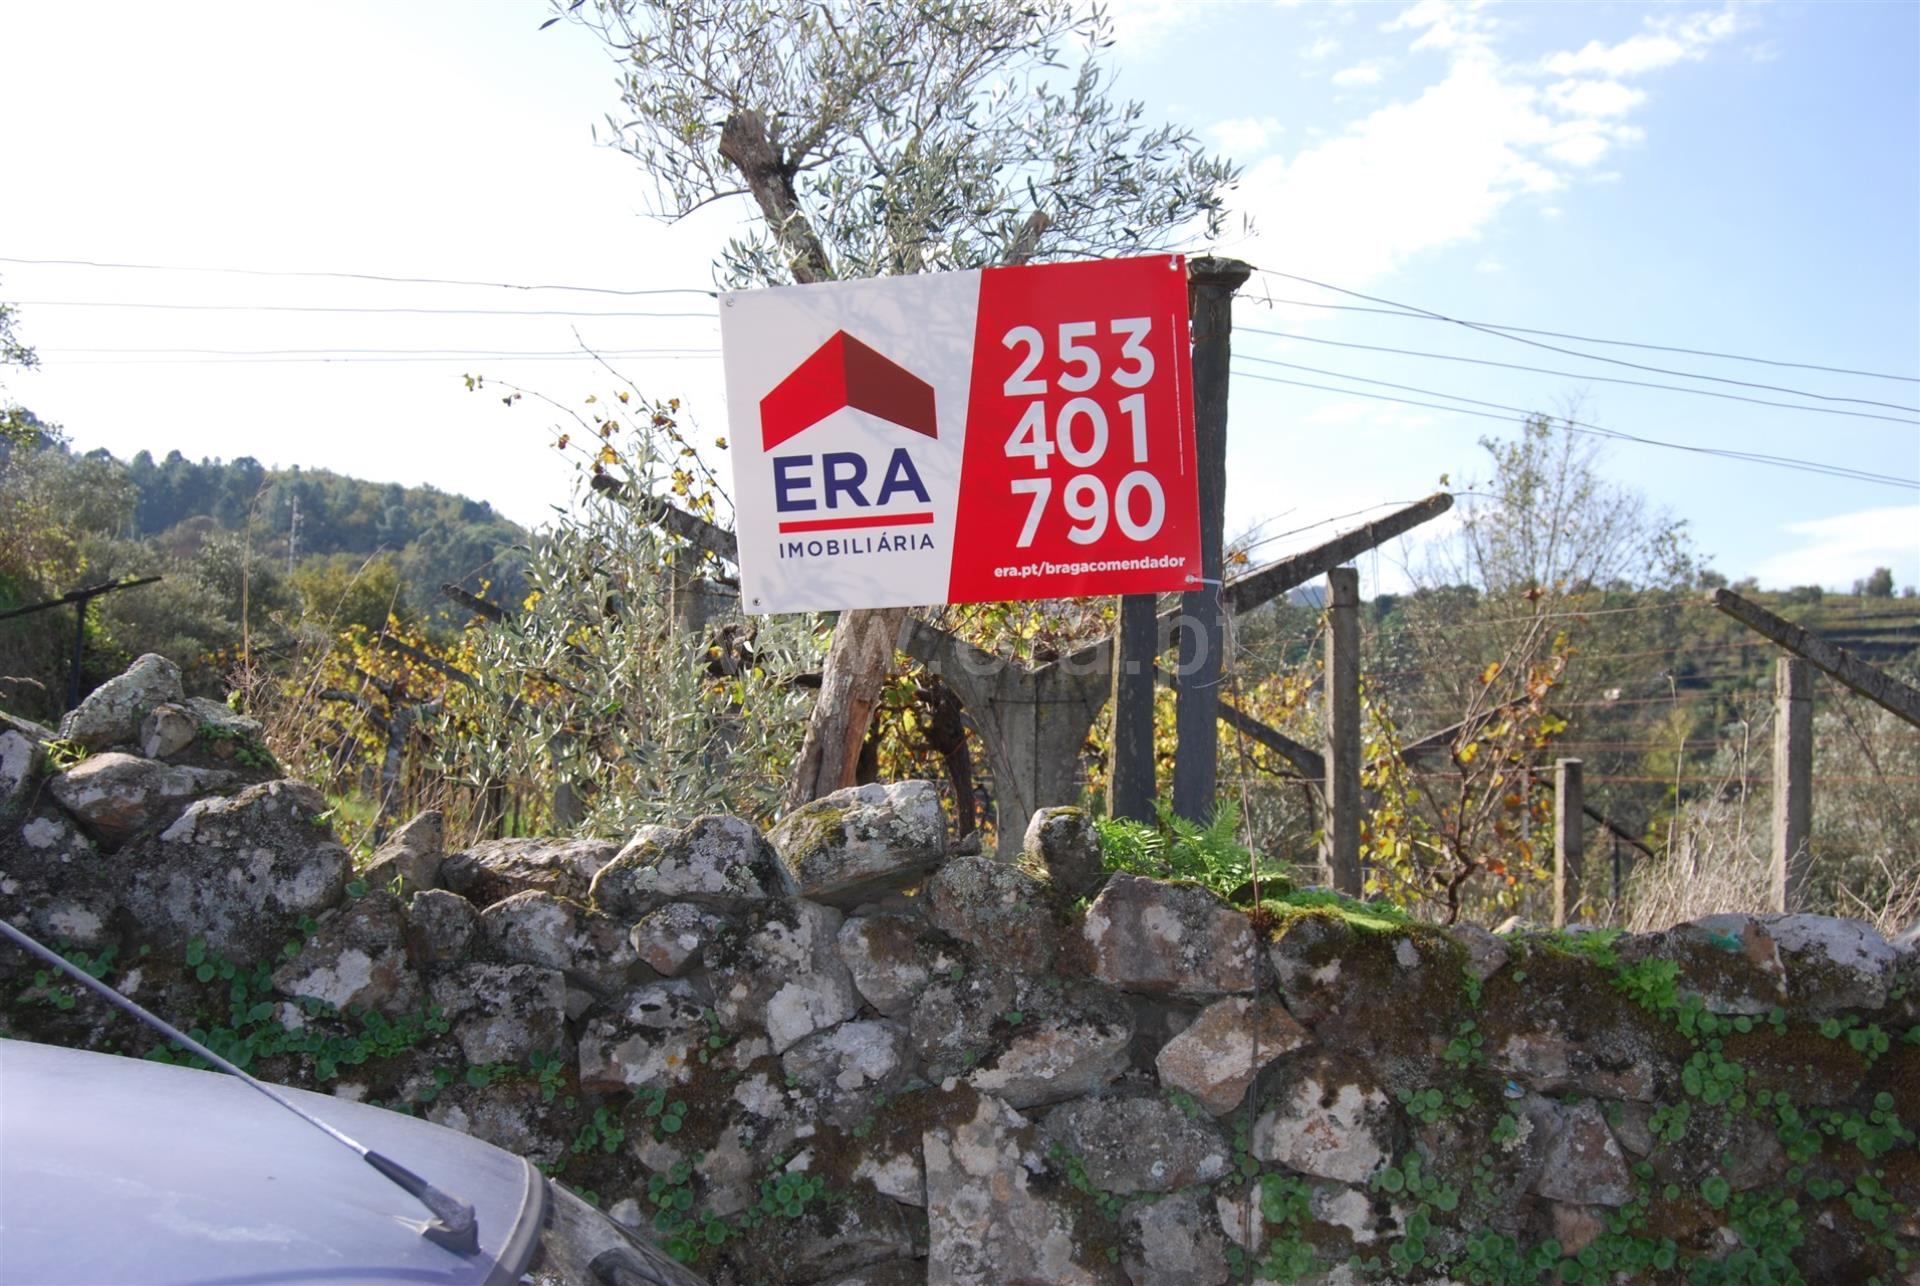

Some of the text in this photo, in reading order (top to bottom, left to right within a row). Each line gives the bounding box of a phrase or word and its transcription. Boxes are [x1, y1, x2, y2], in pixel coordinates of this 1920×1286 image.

[1001, 316, 1155, 397] 253
[1004, 393, 1149, 470] 401
[772, 447, 932, 512] ERA
[1010, 470, 1166, 548] 790
[779, 531, 935, 559] IMOBILIÁRIA
[994, 554, 1186, 579] era.pt/bragacomendador
